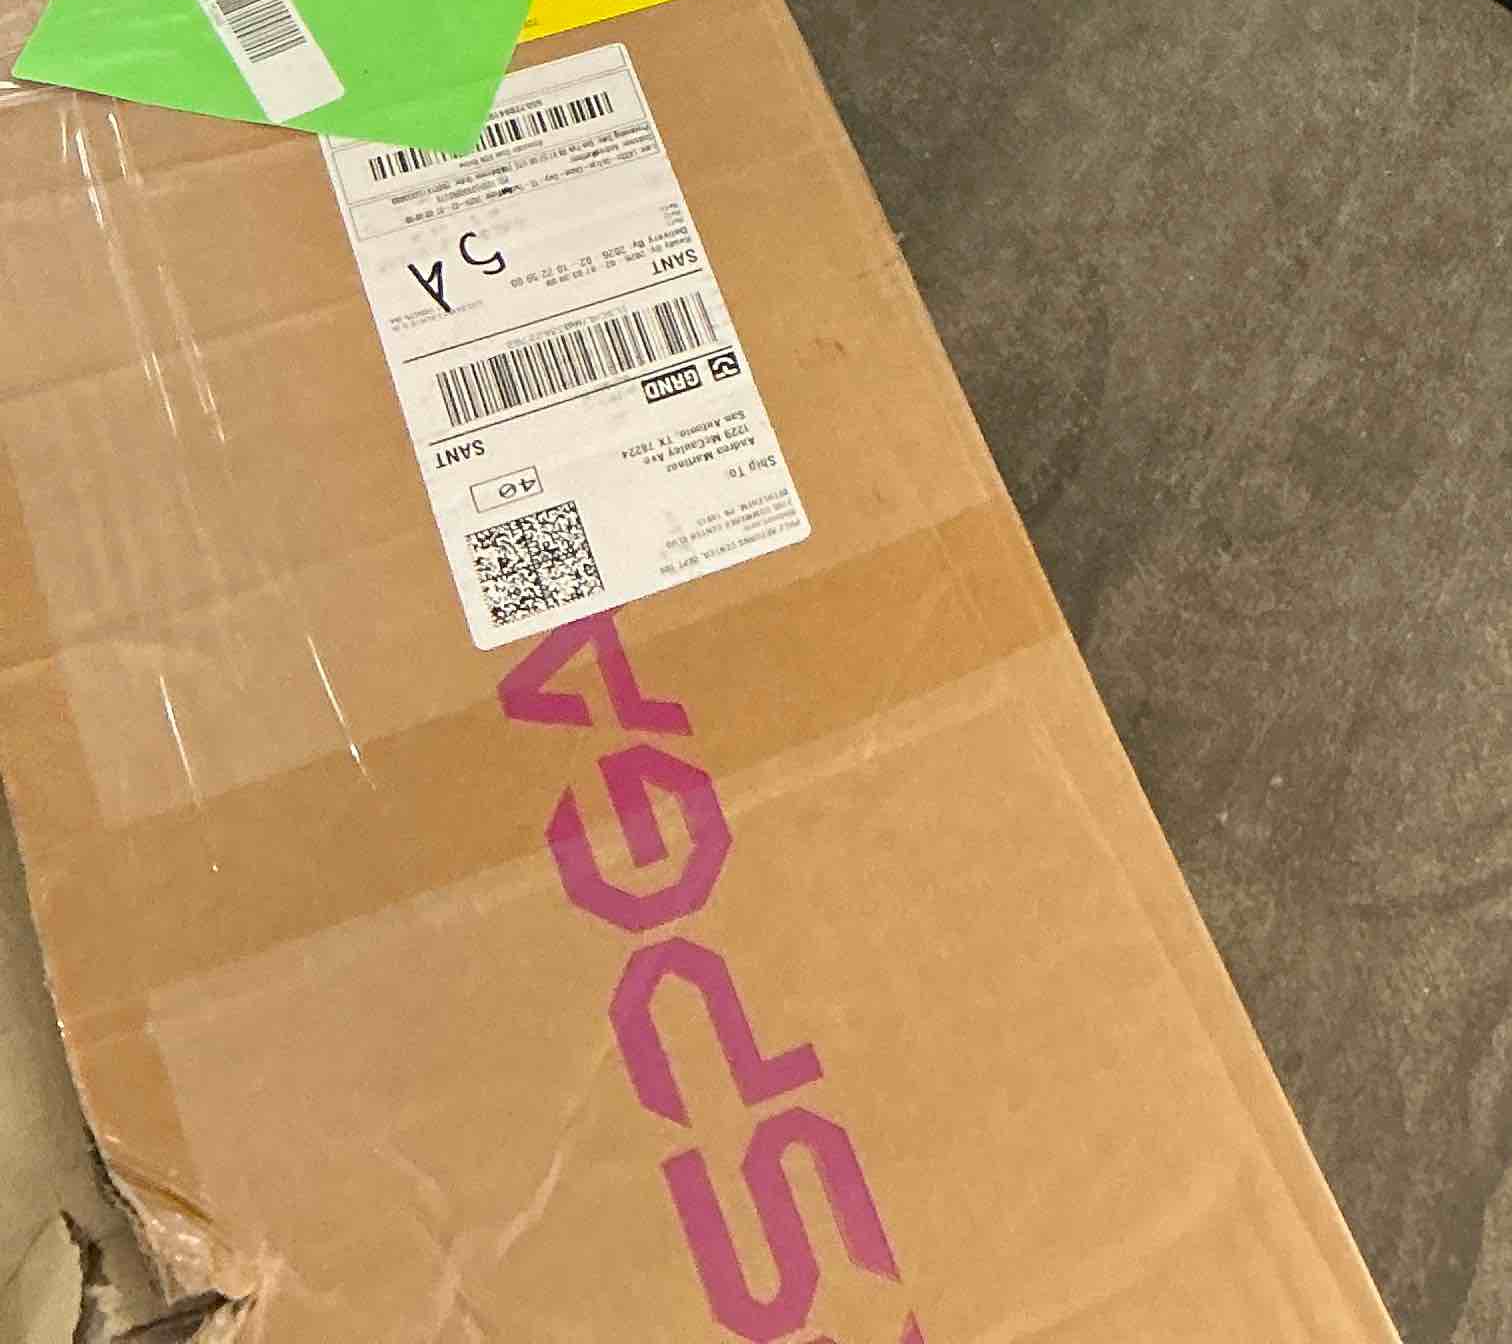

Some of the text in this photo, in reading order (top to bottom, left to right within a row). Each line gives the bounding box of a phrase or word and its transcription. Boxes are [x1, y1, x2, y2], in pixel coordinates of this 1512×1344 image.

[650, 247, 699, 275] SANT
[644, 367, 701, 401] GRND
[433, 437, 487, 470] SANT
[746, 452, 777, 473] Ship
